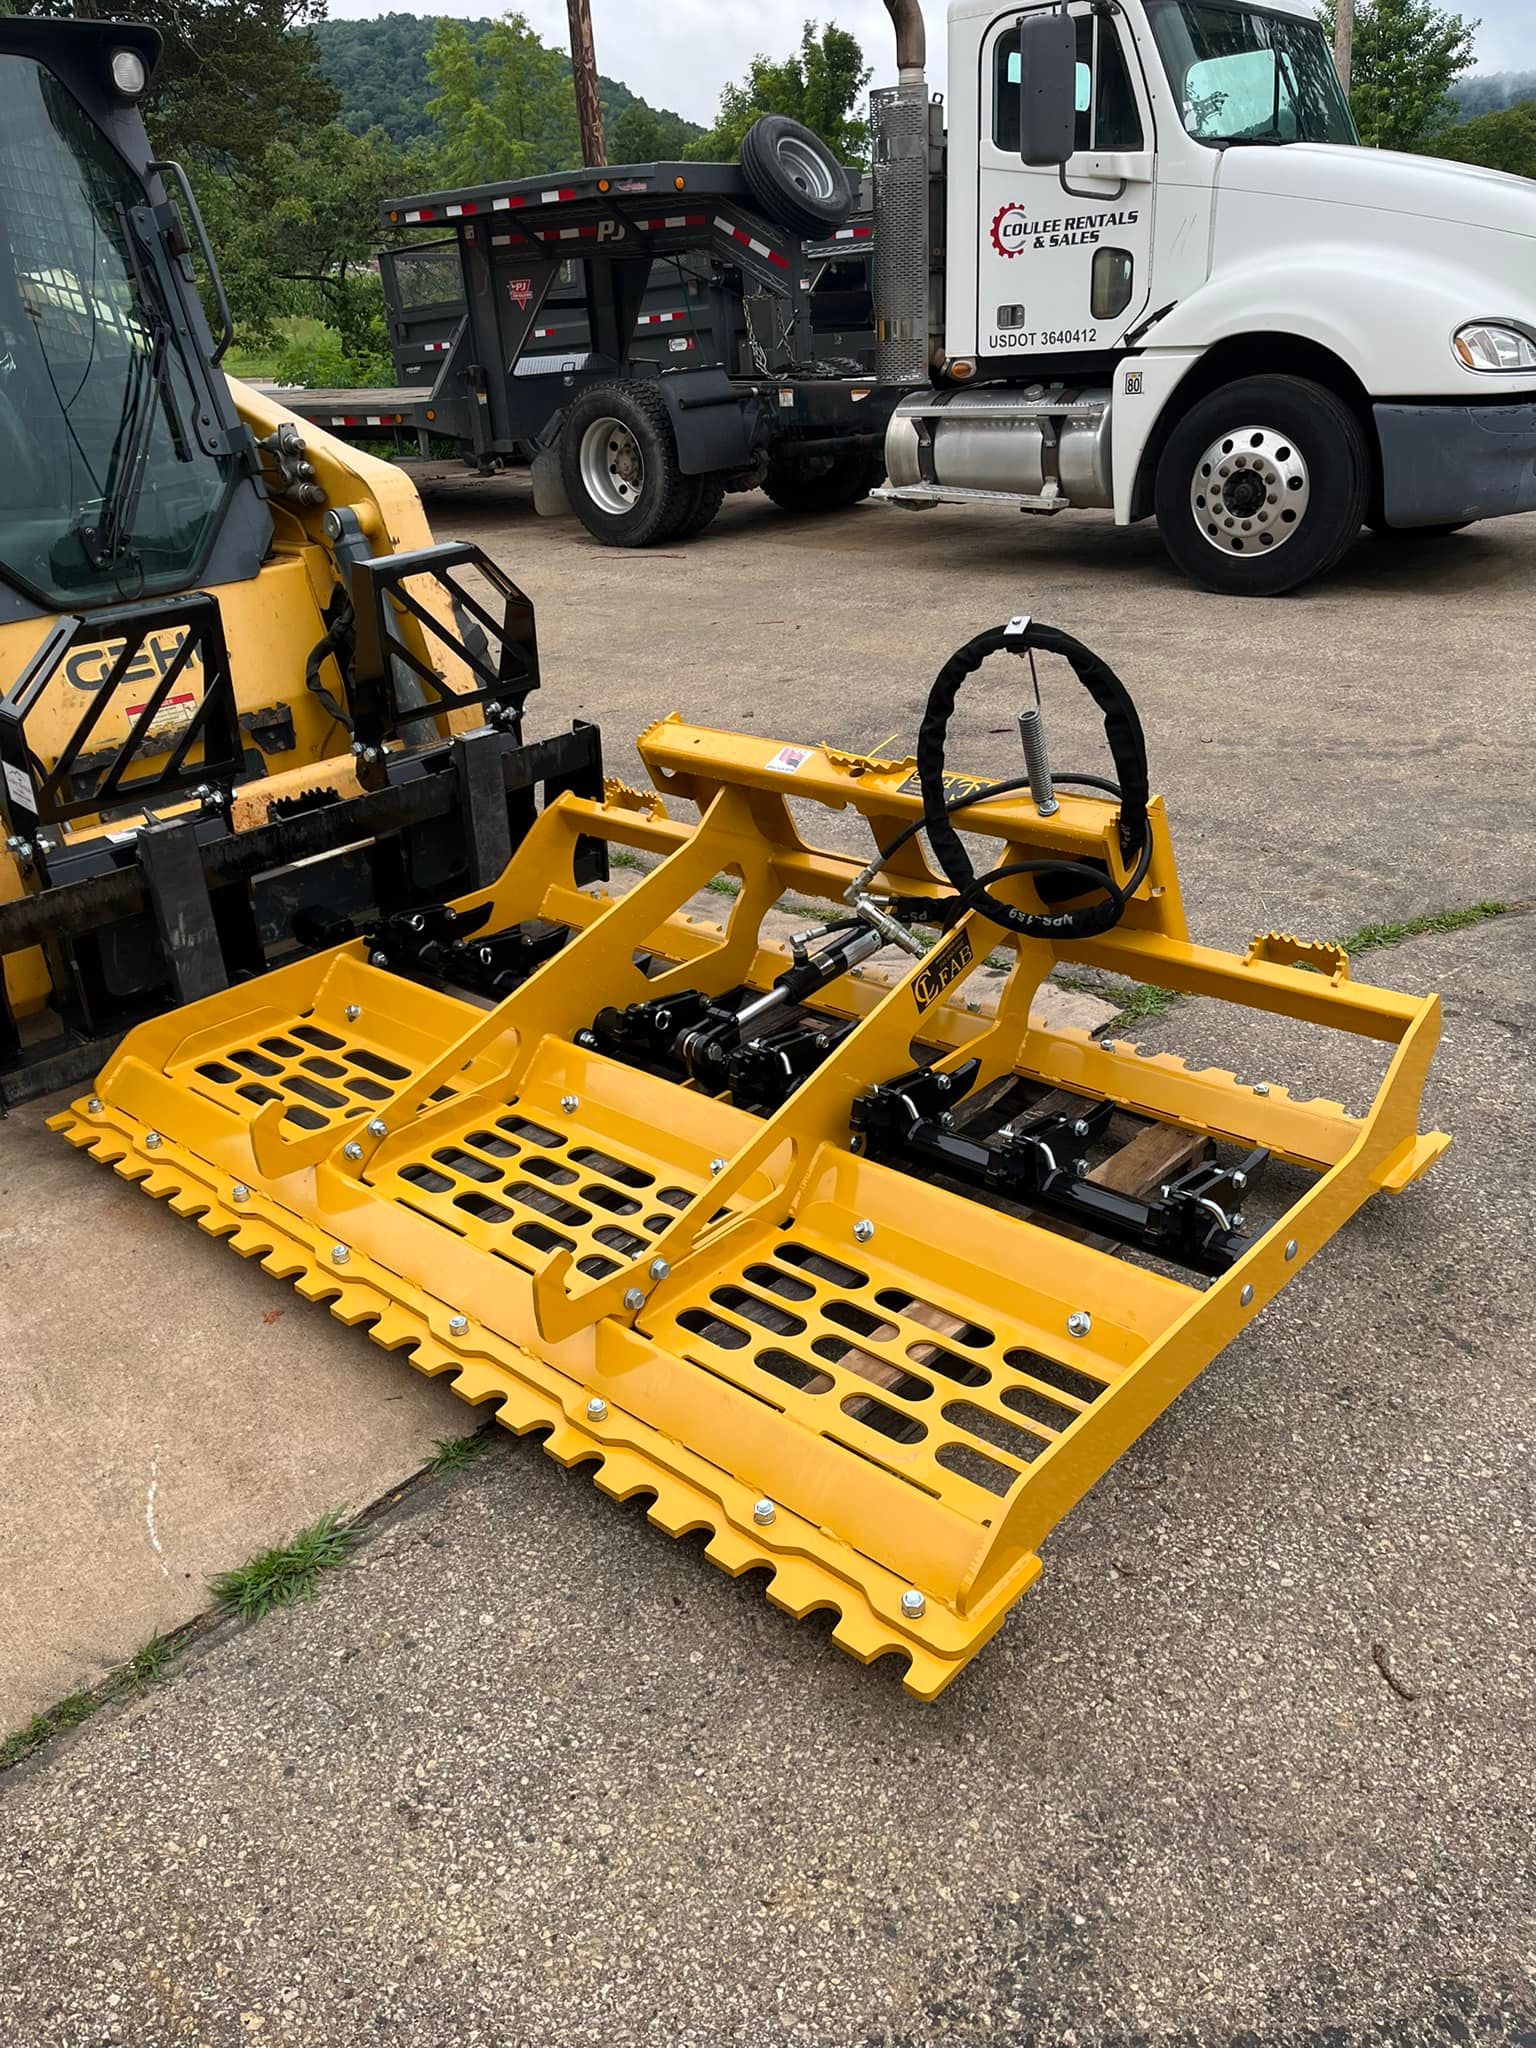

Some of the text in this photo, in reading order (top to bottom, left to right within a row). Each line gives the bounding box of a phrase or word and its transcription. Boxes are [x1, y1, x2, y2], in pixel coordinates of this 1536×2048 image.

[597, 220, 626, 242] PJ
[1003, 210, 1138, 237] COULEE RENTALS
[1033, 230, 1100, 249] & SALES
[989, 328, 1097, 348] USDOT 3640412
[1127, 378, 1140, 392] 80
